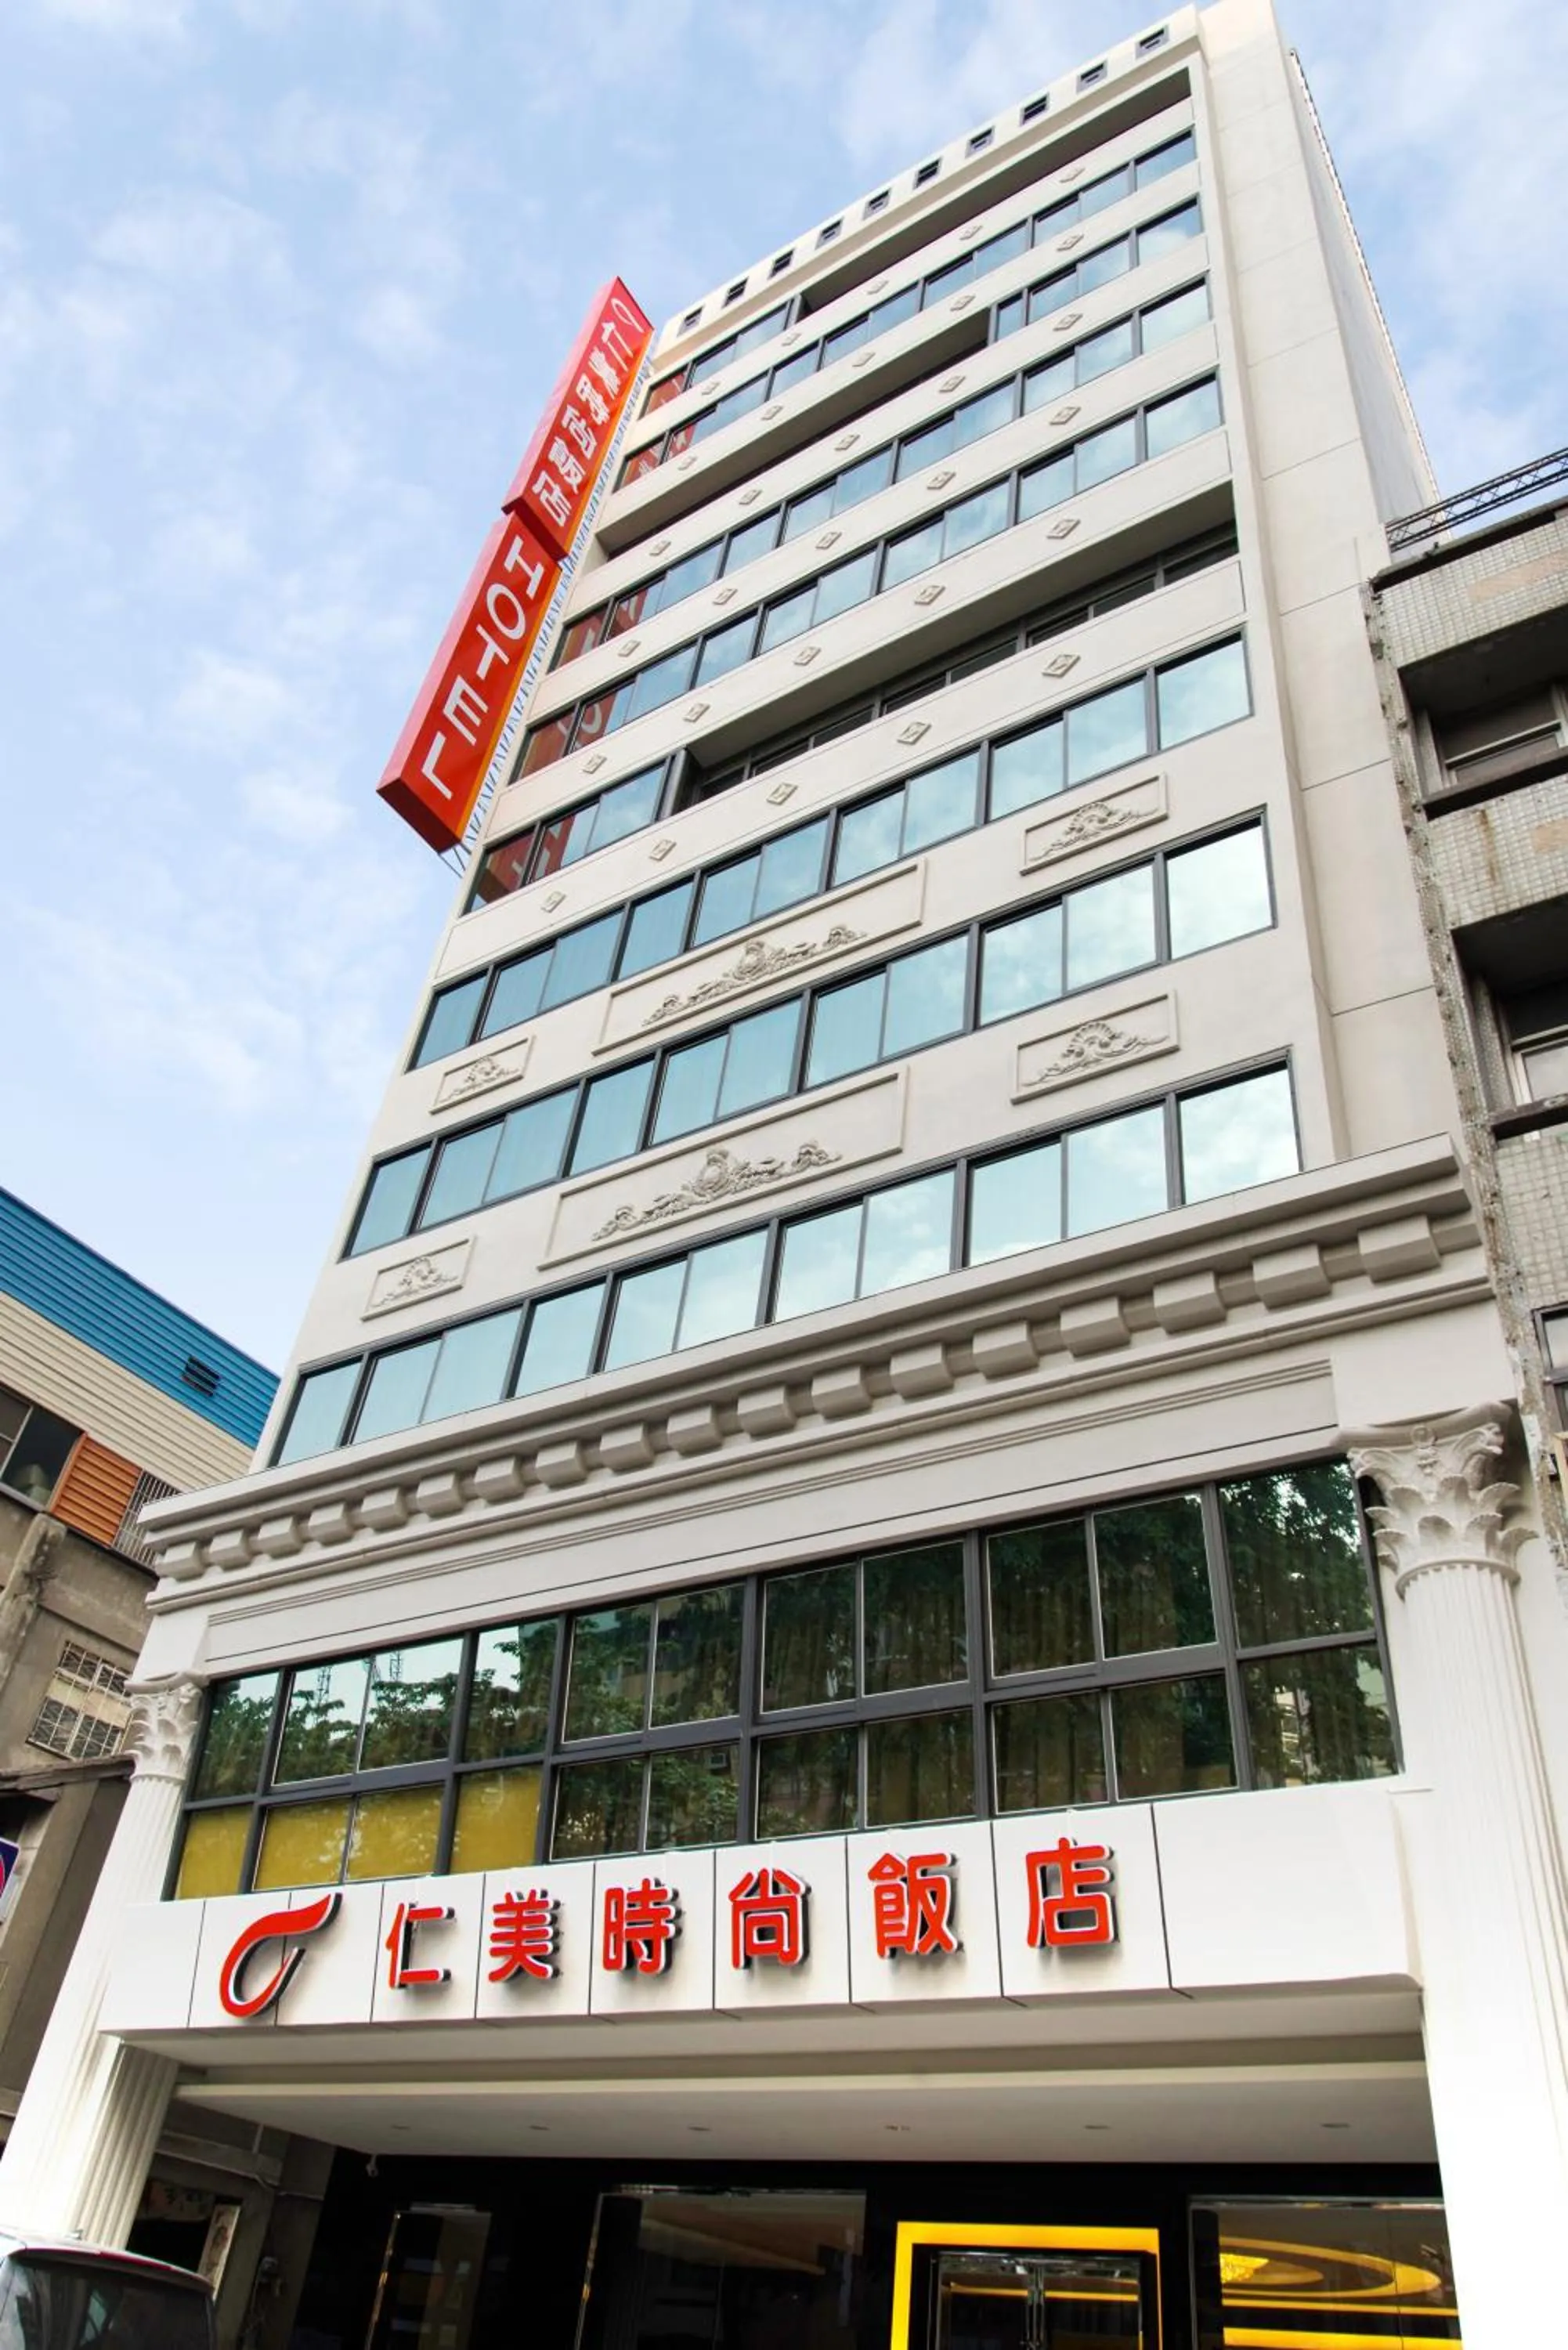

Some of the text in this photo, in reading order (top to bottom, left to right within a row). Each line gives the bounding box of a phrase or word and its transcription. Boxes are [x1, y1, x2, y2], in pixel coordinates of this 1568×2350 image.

[533, 321, 634, 527] 仁美時尚飯店
[421, 536, 544, 800] HOTEL
[385, 1837, 1117, 1989] 仁美時尚飯店
